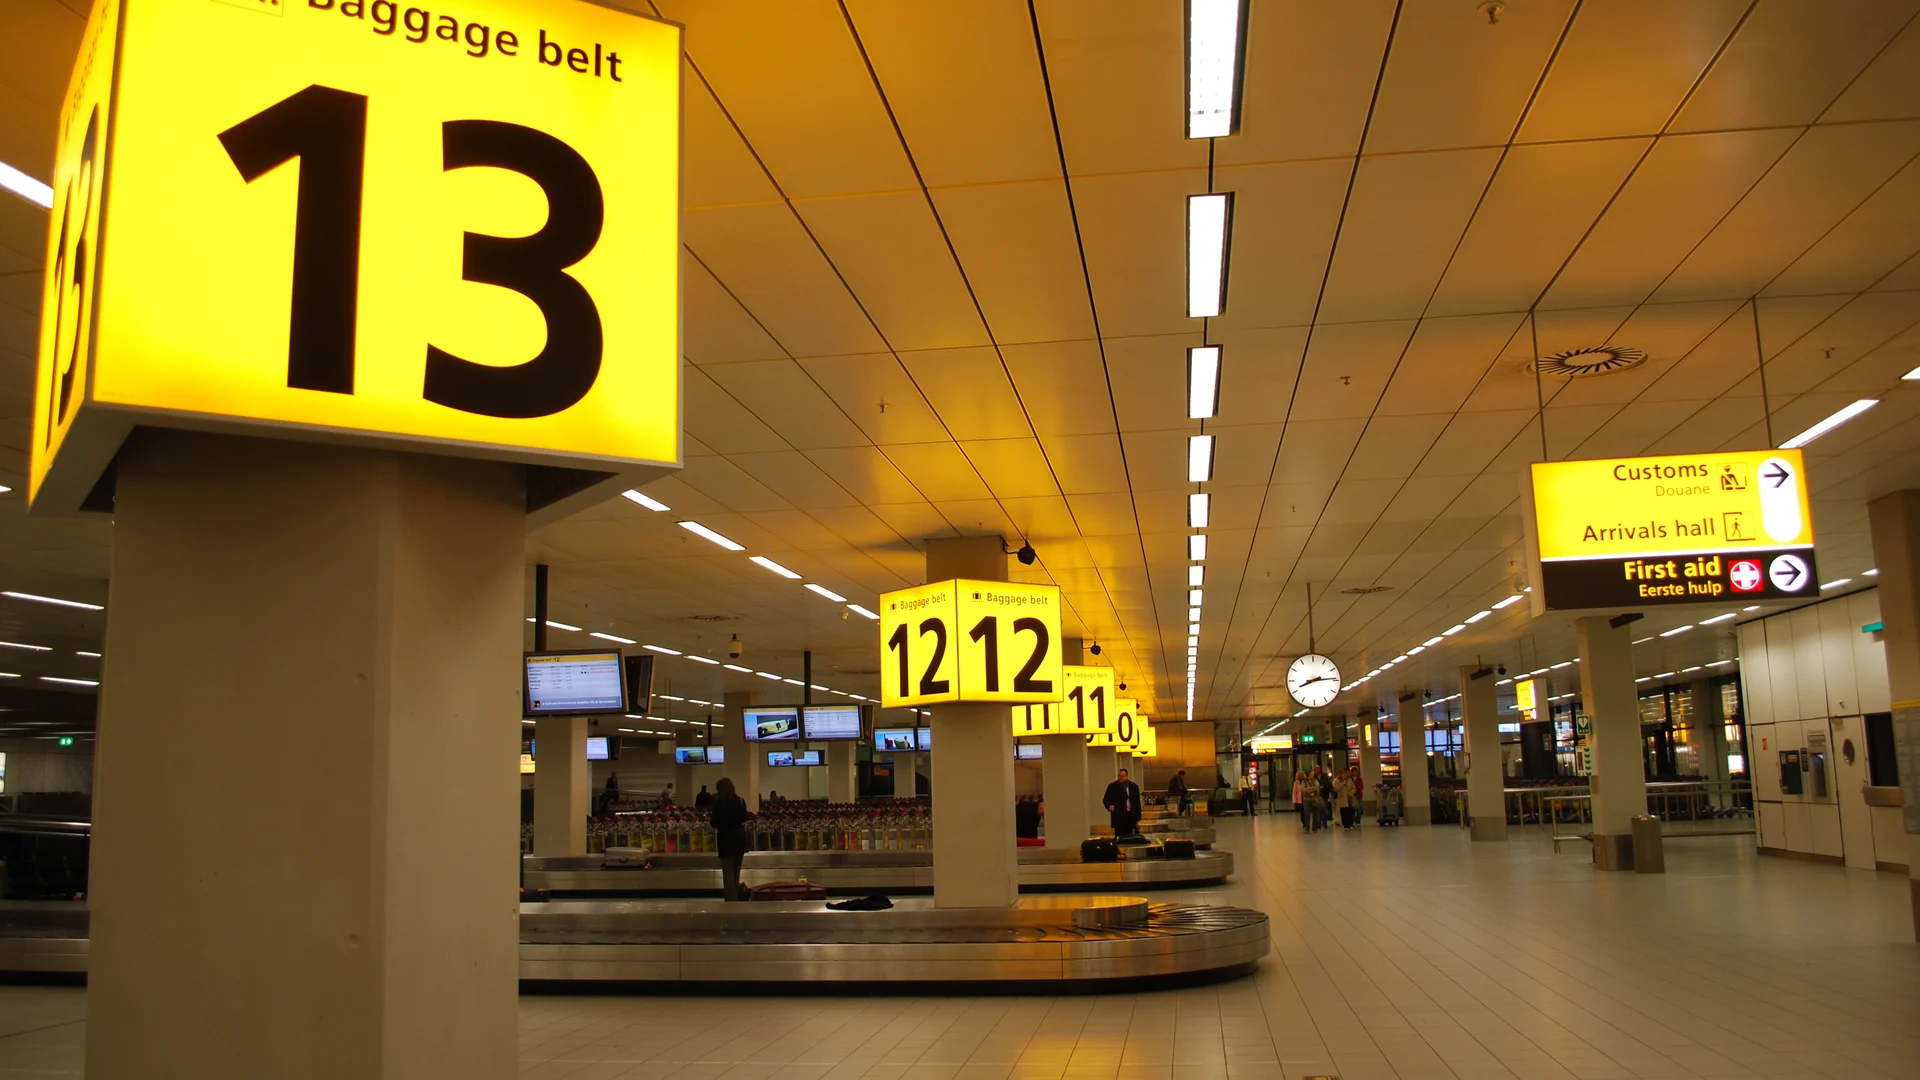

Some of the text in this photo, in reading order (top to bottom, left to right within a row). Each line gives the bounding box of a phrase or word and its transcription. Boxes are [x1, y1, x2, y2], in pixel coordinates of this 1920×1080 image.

[538, 29, 623, 83] belt
[217, 83, 605, 420] 13
[1613, 463, 1708, 482] Customs
[1655, 484, 1711, 497] Douane
[1583, 518, 1716, 542] Arrivals hall
[1624, 556, 1722, 581] First aid
[986, 592, 1049, 607] Baggage belt
[1639, 580, 1723, 598] Eerste hulp
[900, 593, 946, 611] Baggage belt
[888, 617, 950, 698] 12
[968, 615, 1053, 693] 12
[1068, 686, 1106, 729] 11
